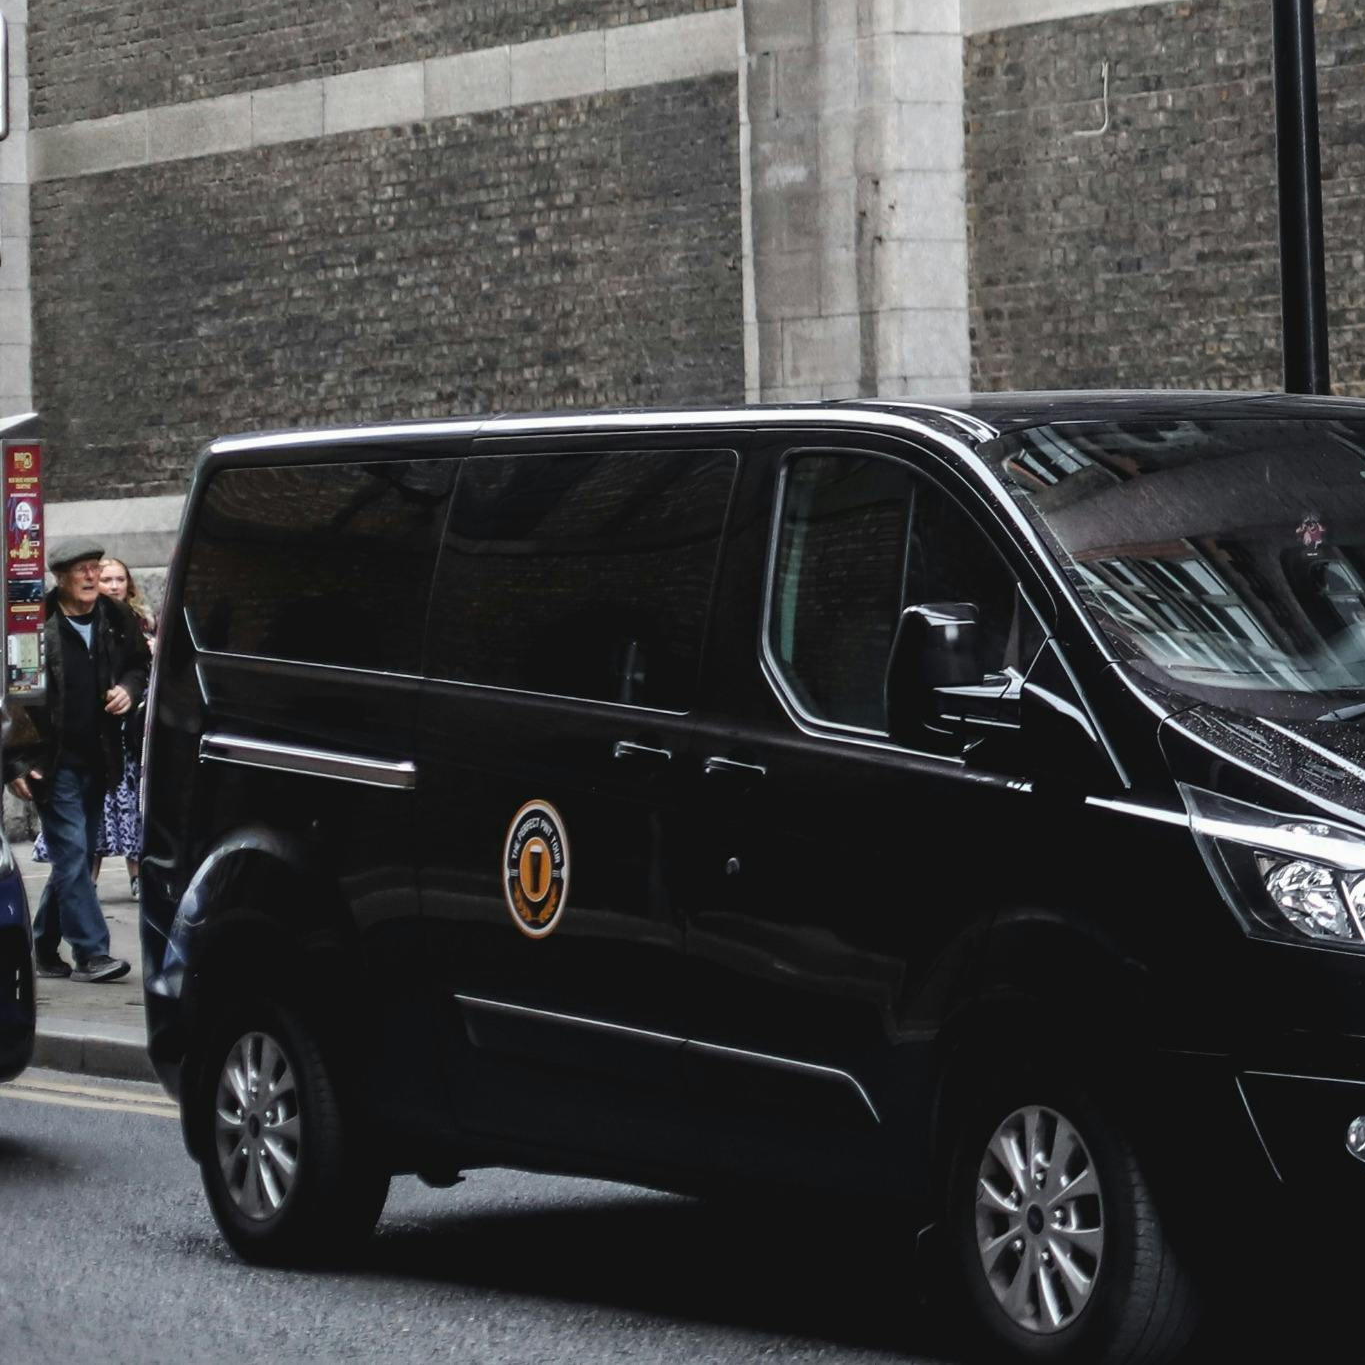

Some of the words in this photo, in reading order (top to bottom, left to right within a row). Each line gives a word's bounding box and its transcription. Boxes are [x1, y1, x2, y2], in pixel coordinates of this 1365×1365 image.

[512, 839, 521, 859] THE
[517, 817, 540, 841] PERFECT
[540, 820, 553, 837] PINT
[550, 836, 561, 863] TOUR
